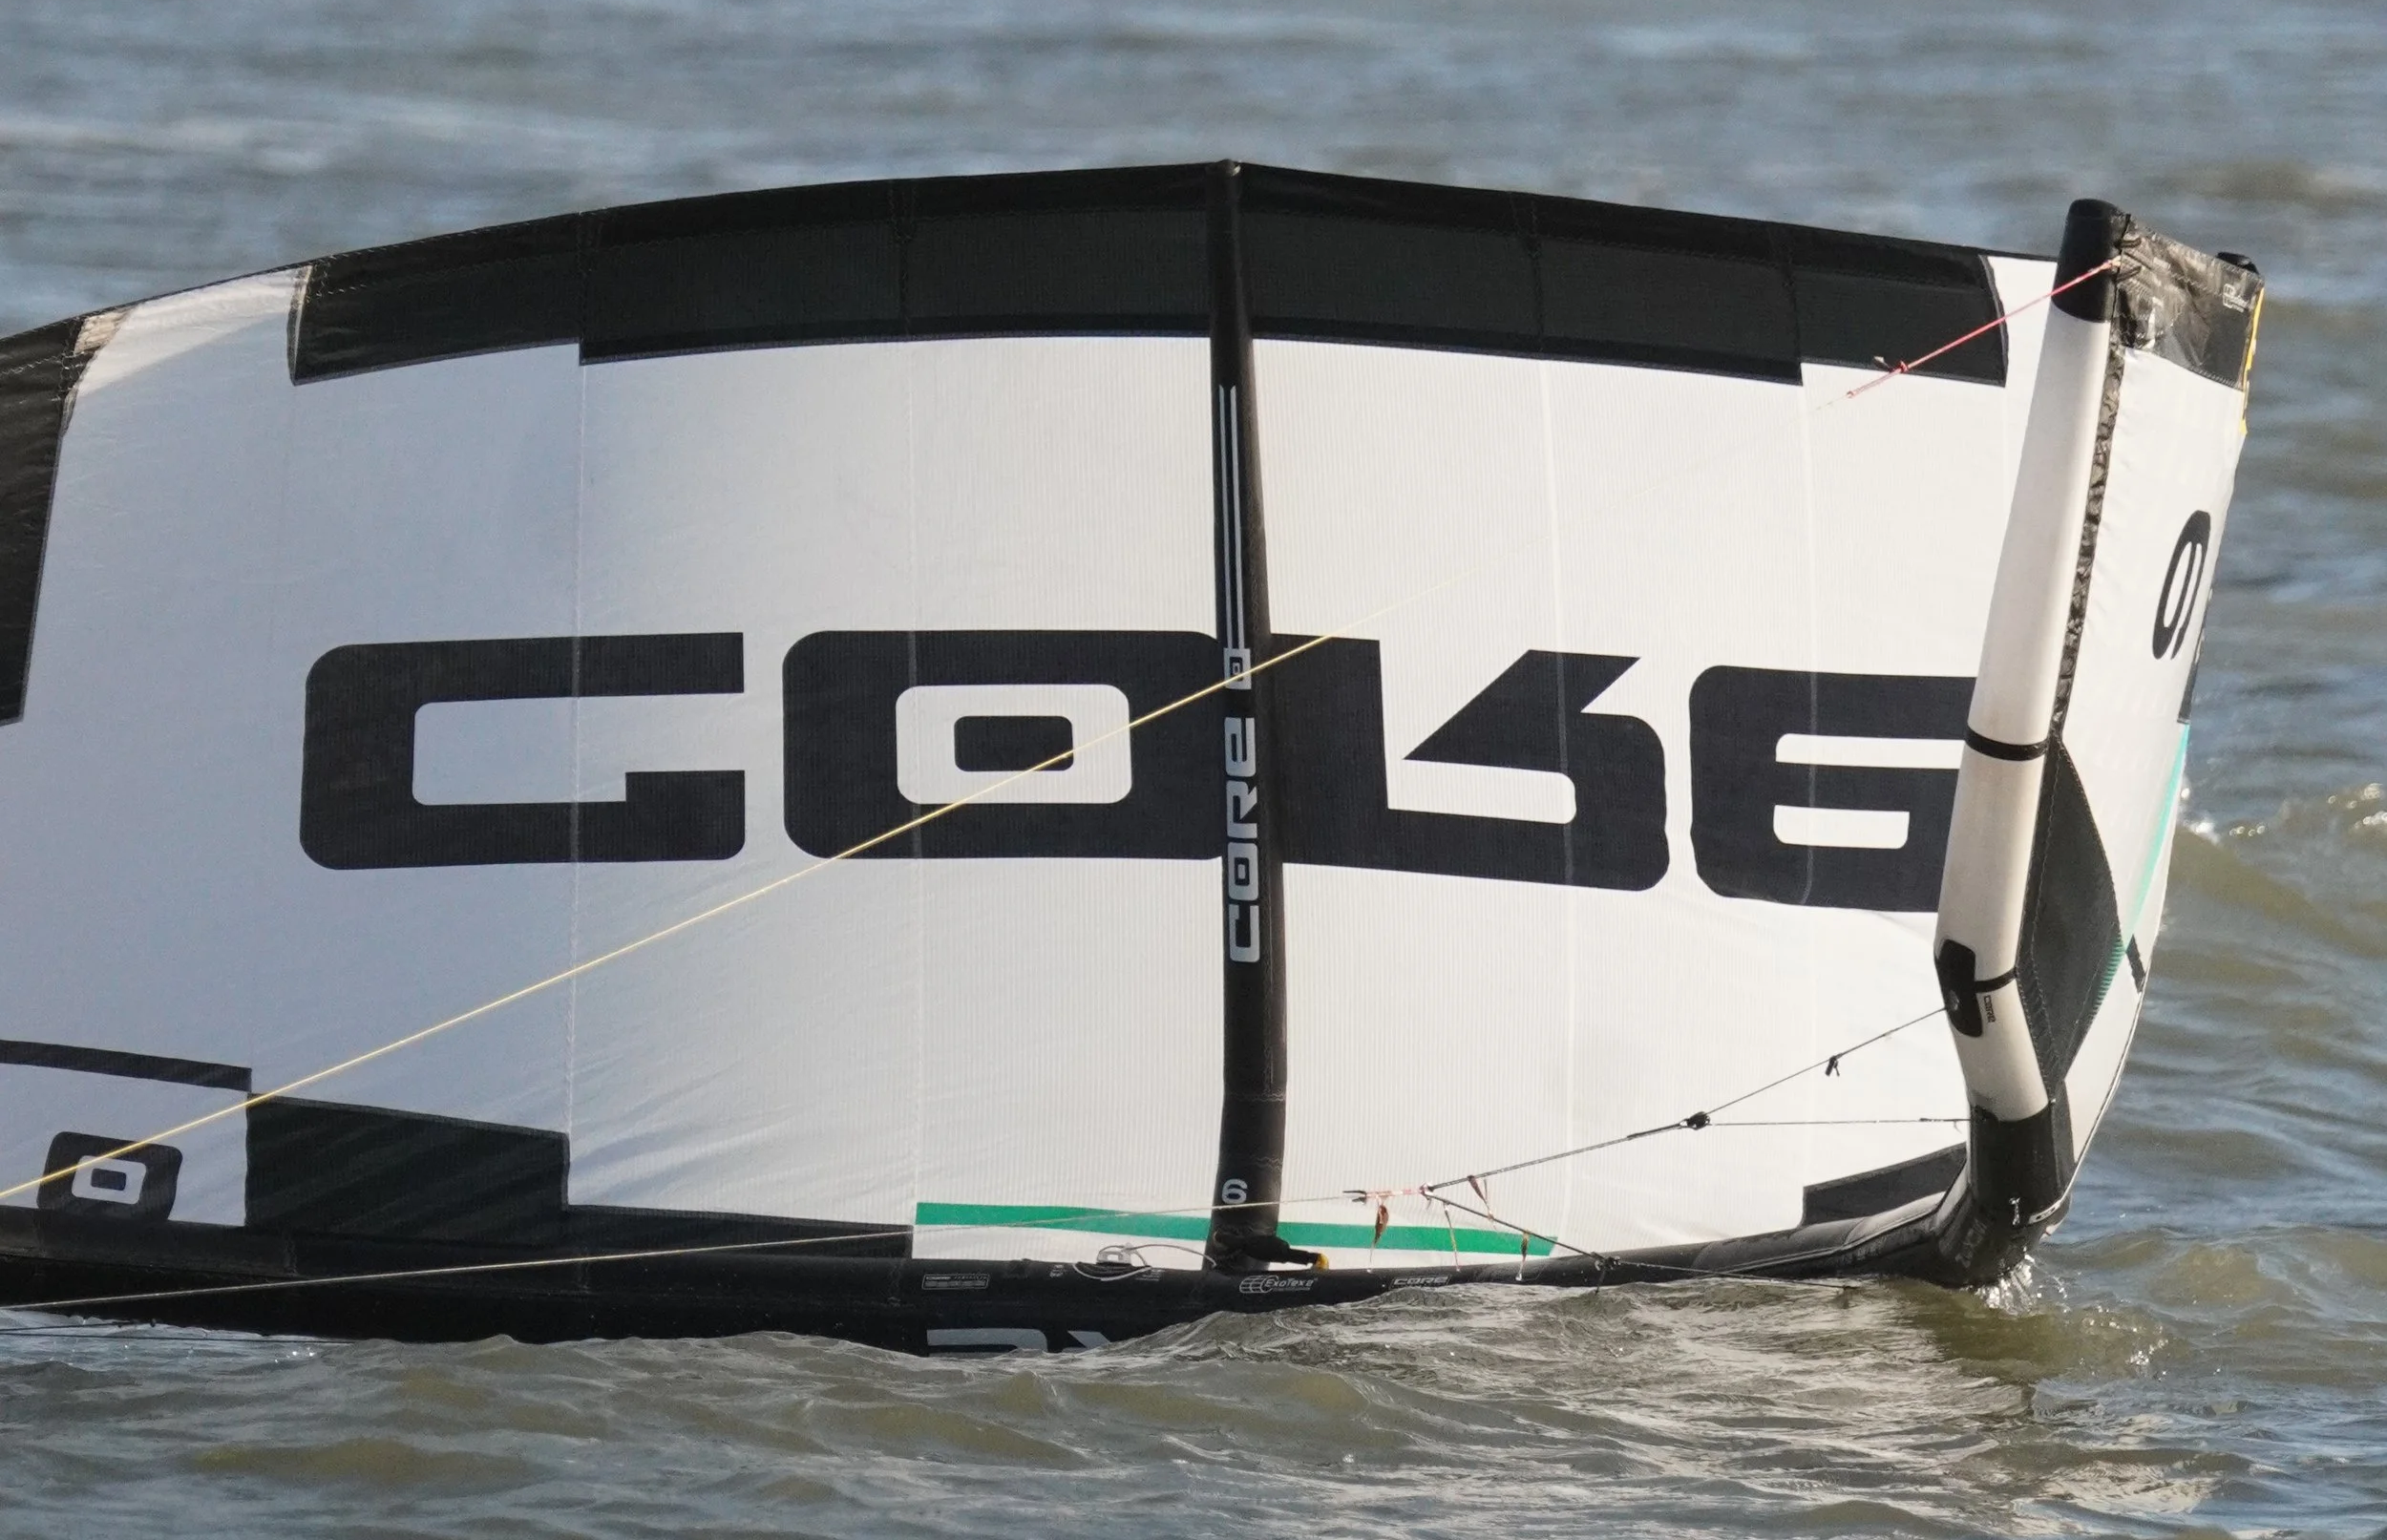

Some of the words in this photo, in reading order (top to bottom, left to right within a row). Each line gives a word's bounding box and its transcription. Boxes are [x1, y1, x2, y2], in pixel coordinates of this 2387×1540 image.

[1224, 717, 1259, 962] CORE
[1222, 1178, 1248, 1204] 6
[1394, 1276, 1448, 1286] CORE
